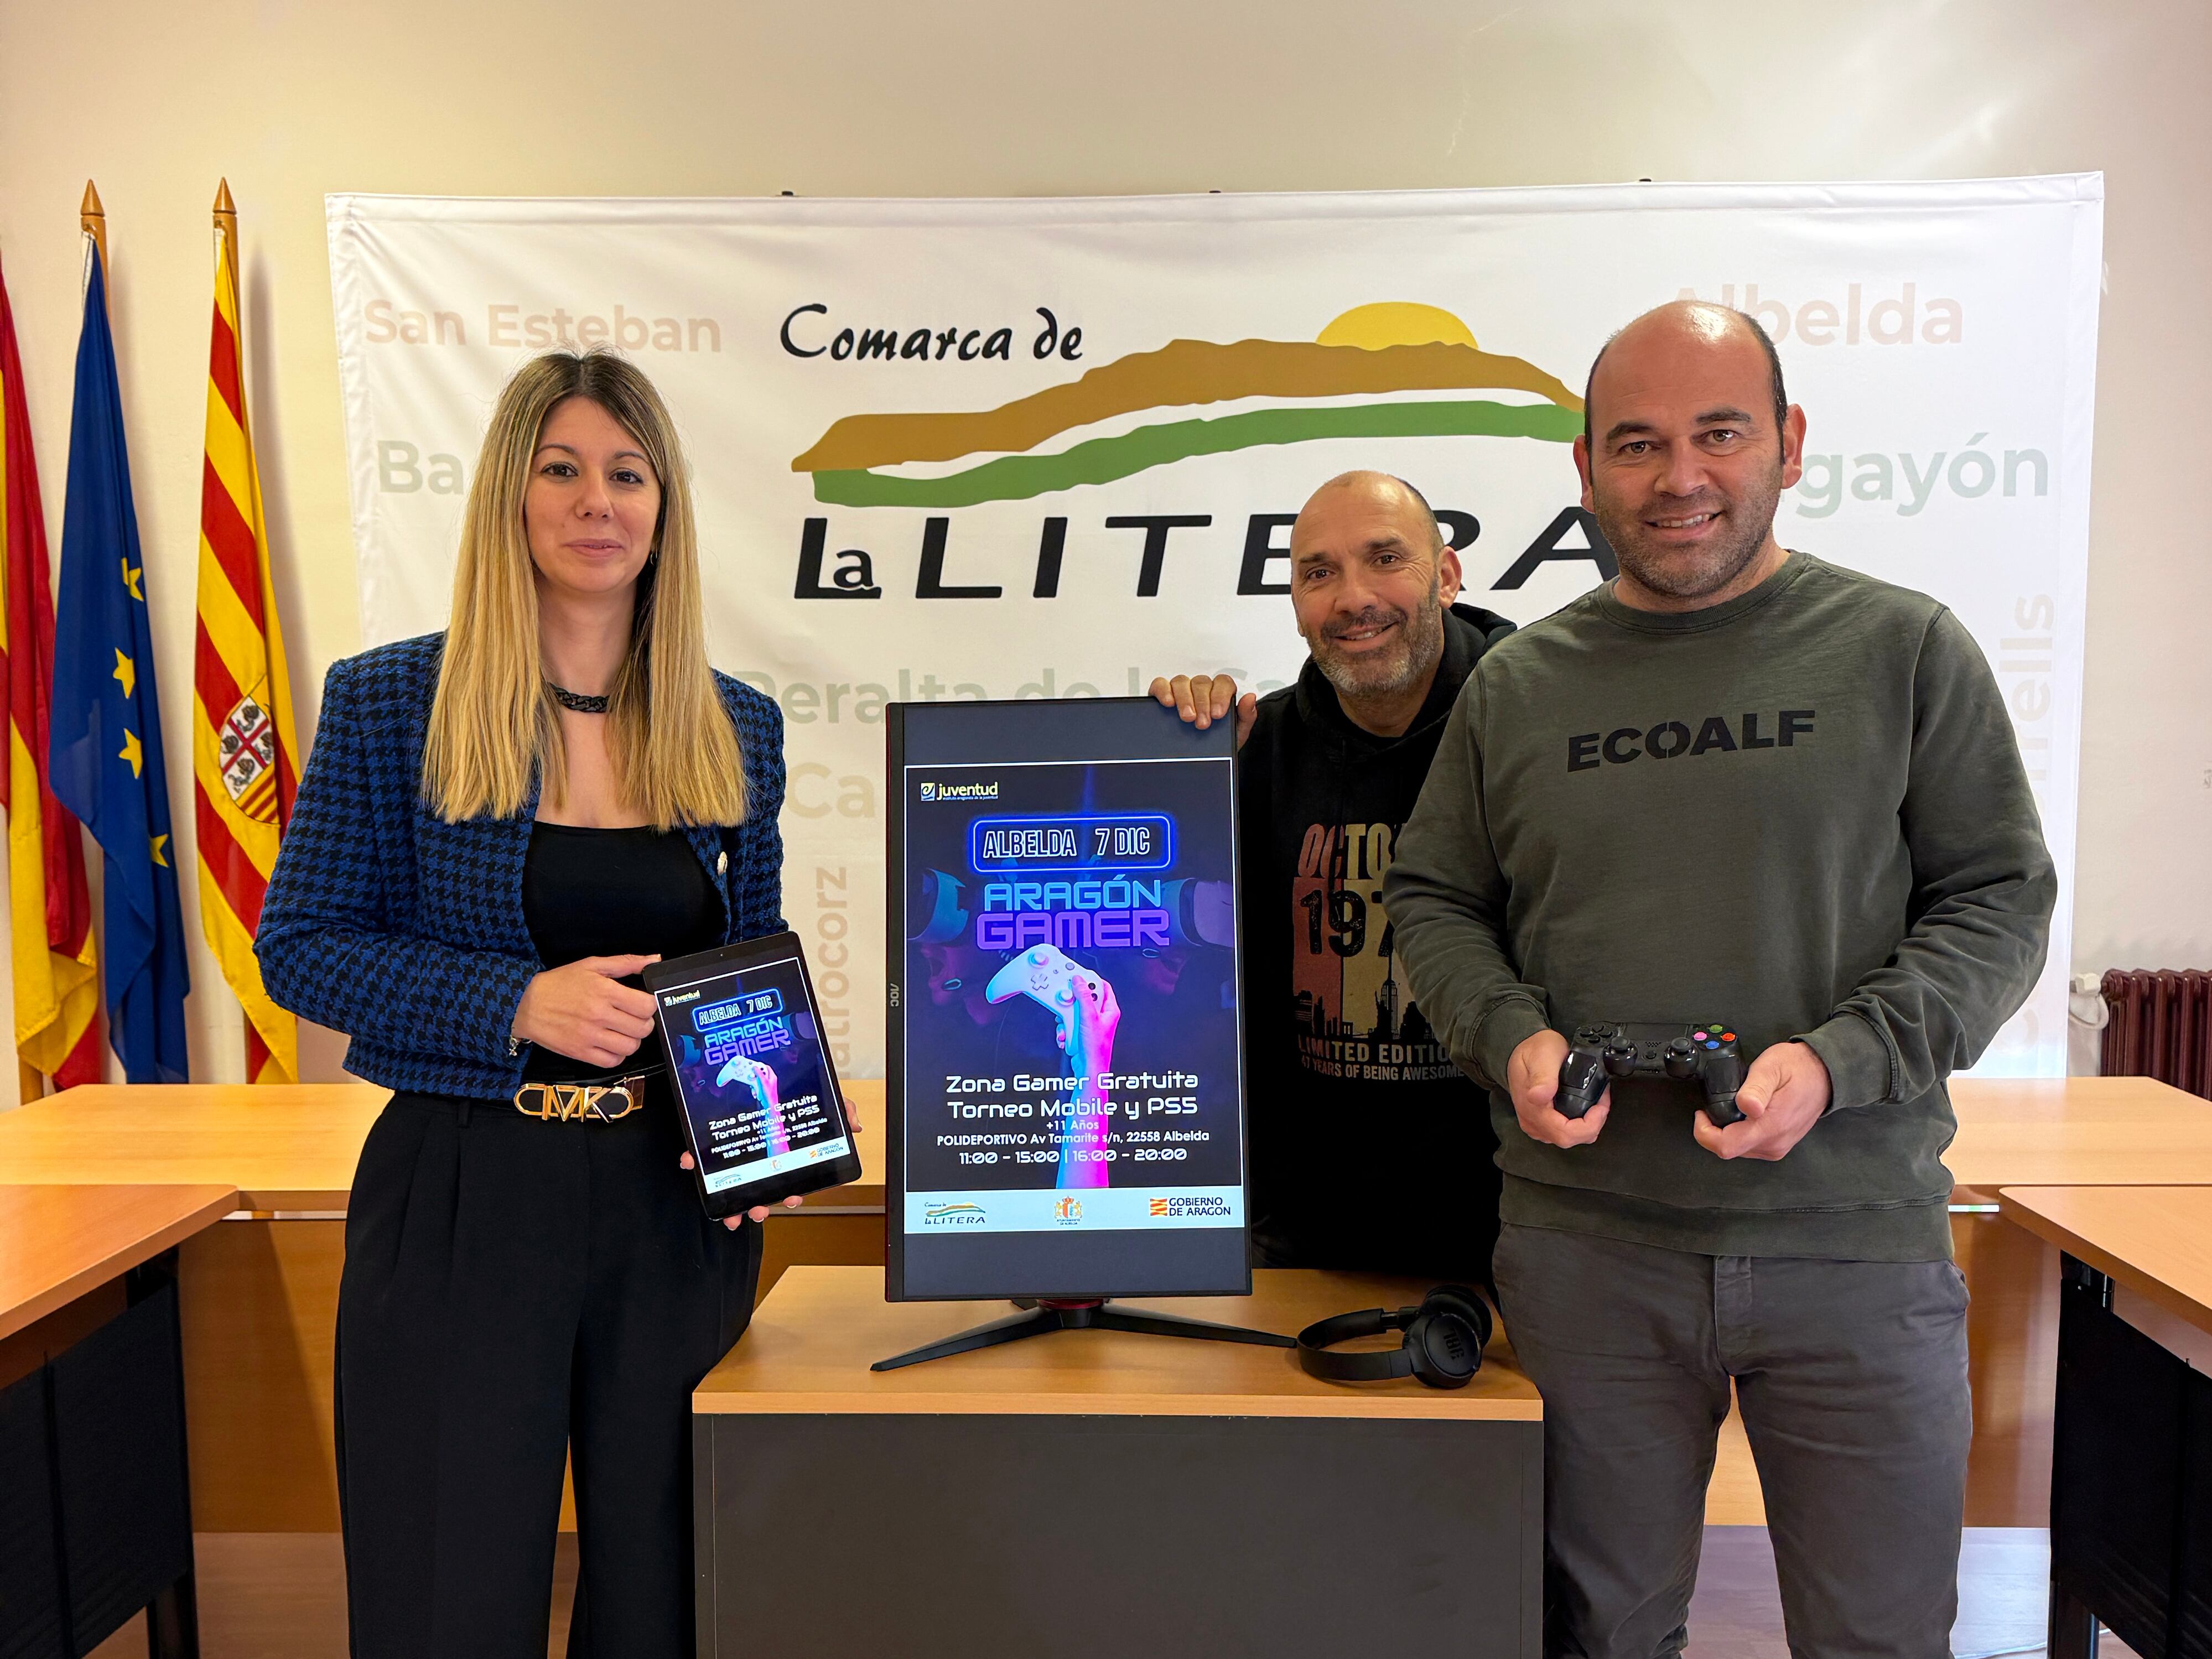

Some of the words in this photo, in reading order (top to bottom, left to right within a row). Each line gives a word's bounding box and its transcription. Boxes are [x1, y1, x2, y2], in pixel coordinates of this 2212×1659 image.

[365, 299, 465, 346] San
[488, 304, 721, 353] Esteban
[1675, 283, 1964, 346] belda
[780, 304, 1013, 361] Comarca
[1033, 307, 1083, 361] de
[1796, 433, 2049, 519] gayón
[794, 518, 881, 599] La
[1998, 594, 2054, 819] rells
[1567, 710, 1815, 772] ECOALF
[937, 782, 998, 800] juventud
[983, 829, 1077, 858] ALBELDA
[1095, 828, 1110, 856] 7
[1115, 828, 1151, 855] DIC
[1298, 823, 1395, 880] OCTO
[984, 874, 1161, 911] ARAGÓN
[977, 909, 1170, 950] GAMER
[816, 867, 850, 1079] atrocorz
[890, 983, 899, 1007] AOC
[699, 1003, 741, 1025] ALBELDA
[746, 999, 754, 1013] 7
[704, 1016, 783, 1048] ARAGÓN
[704, 1029, 791, 1065] GAMER
[1299, 1033, 1370, 1062] LIMITED
[946, 1075, 1005, 1093] Zona
[1013, 1074, 1089, 1091] Gamer
[1097, 1070, 1198, 1090] Gratuita
[1313, 1059, 1342, 1077] YEARS
[1346, 1064, 1360, 1078] OF
[1364, 1064, 1399, 1080] BEING
[1403, 1064, 1465, 1080] AWESOME
[709, 1117, 736, 1130] Zona
[738, 1108, 771, 1122] Gamer
[774, 1095, 817, 1112] Gratuita
[947, 1101, 1033, 1119] Torneo
[1041, 1098, 1117, 1117] Mobile
[1125, 1100, 1140, 1120] y
[1147, 1097, 1198, 1115] PS5
[712, 1125, 751, 1141] Torneo
[752, 1114, 786, 1130] Mobile
[788, 1112, 796, 1122] y
[937, 1135, 1027, 1146] POLIDEPORTIVO
[1030, 1134, 1046, 1144] Av
[1048, 1133, 1099, 1144] Tamarite
[1102, 1132, 1124, 1145] s/n,
[1126, 1132, 1160, 1142] 22558
[1163, 1131, 1210, 1142] Albelda
[1047, 1120, 1066, 1130] +11
[1071, 1119, 1099, 1130] Años
[959, 1152, 998, 1164] 11:00
[1015, 1151, 1060, 1163] 15:00
[1073, 1149, 1117, 1162] 16:00
[1134, 1148, 1188, 1161] 20:00
[1169, 1197, 1223, 1206] GOBIERNO
[1169, 1208, 1183, 1216] DE
[1187, 1206, 1230, 1216] ARAGON
